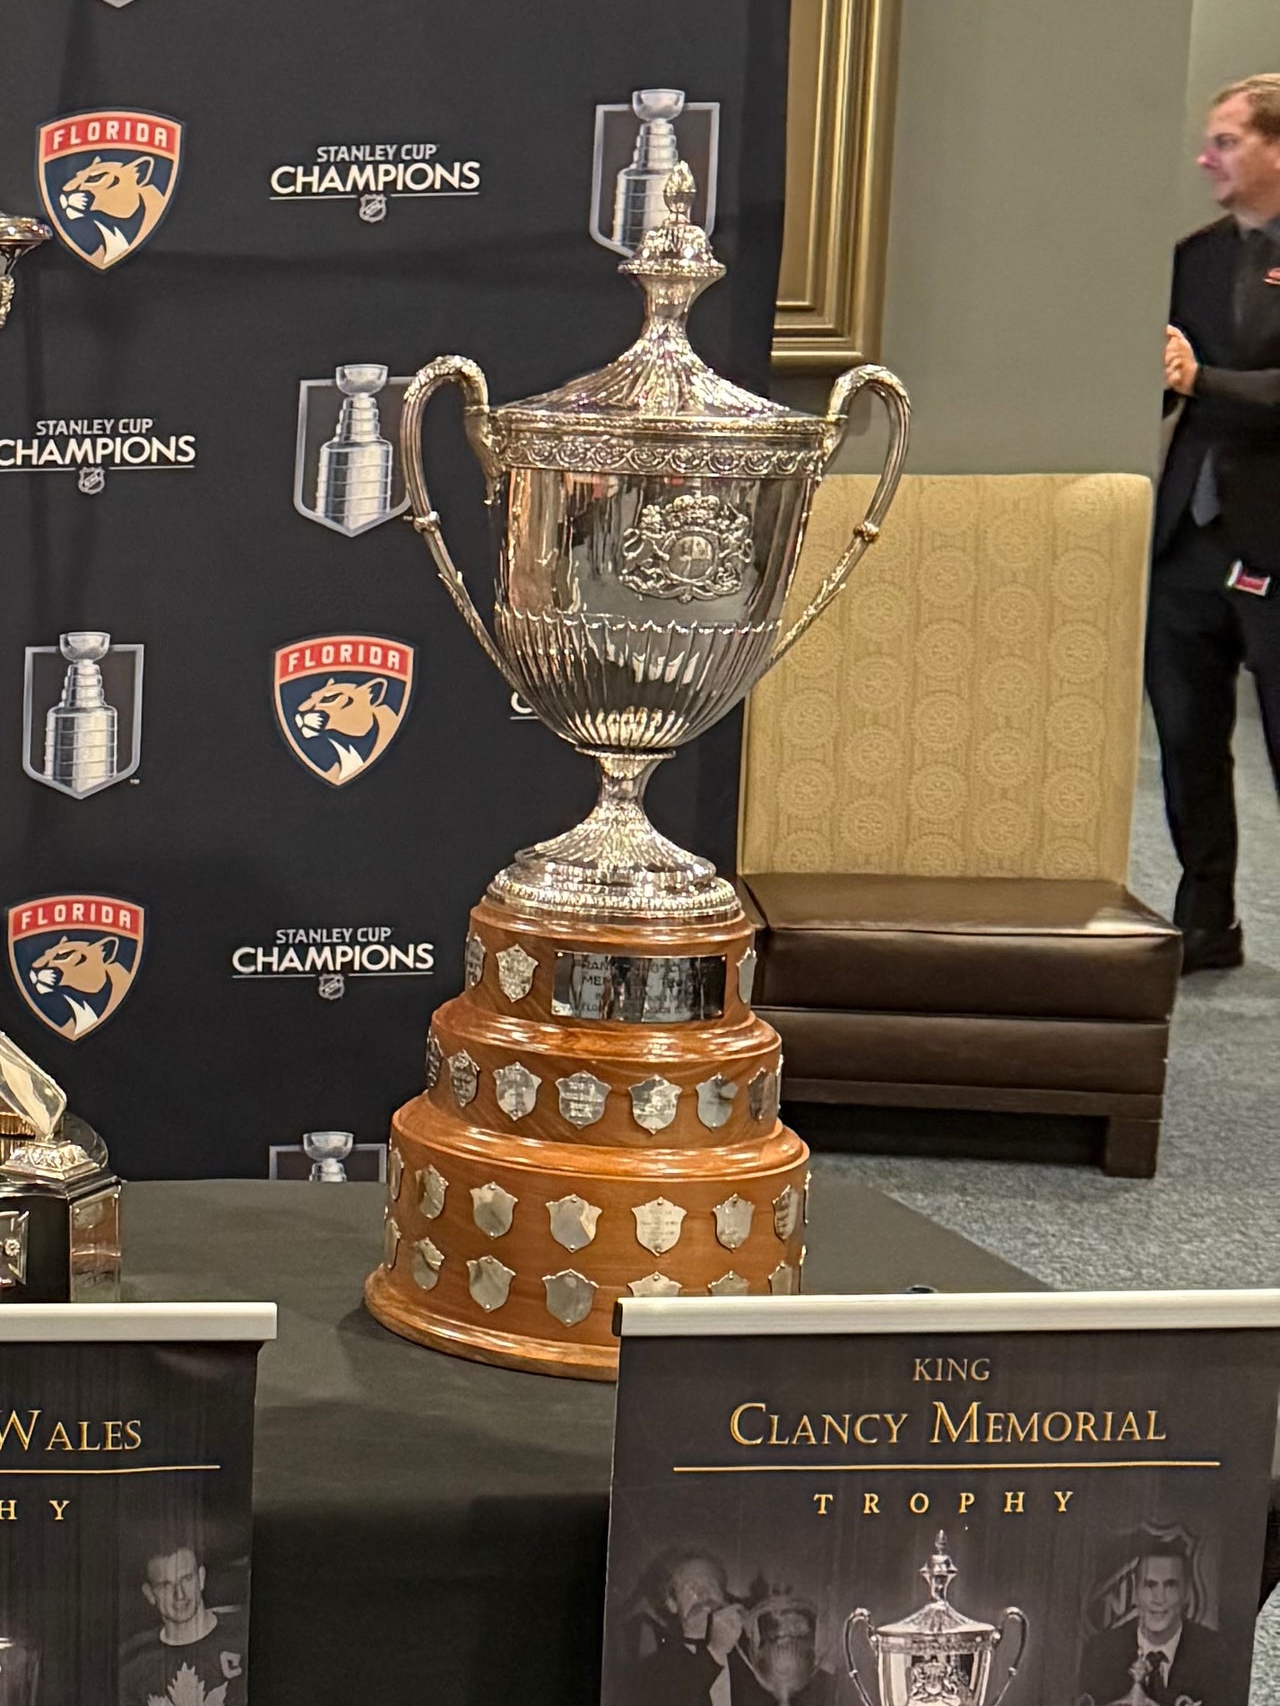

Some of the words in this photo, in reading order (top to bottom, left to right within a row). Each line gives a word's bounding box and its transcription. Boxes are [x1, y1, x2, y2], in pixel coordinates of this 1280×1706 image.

[54, 121, 166, 149] FLORIDA
[317, 145, 397, 162] STANLEY
[402, 144, 436, 160] CUP
[271, 161, 480, 193] CHAMPIONS
[36, 419, 114, 435] STANLEY
[119, 419, 152, 433] CUP
[289, 645, 399, 671] FLORIDA
[22, 904, 130, 929] FLORIDA
[277, 928, 352, 943] STANLEY
[358, 927, 391, 941] CUP
[233, 943, 433, 973] CHAMPIONS
[813, 1490, 1074, 1515] TROPHY
